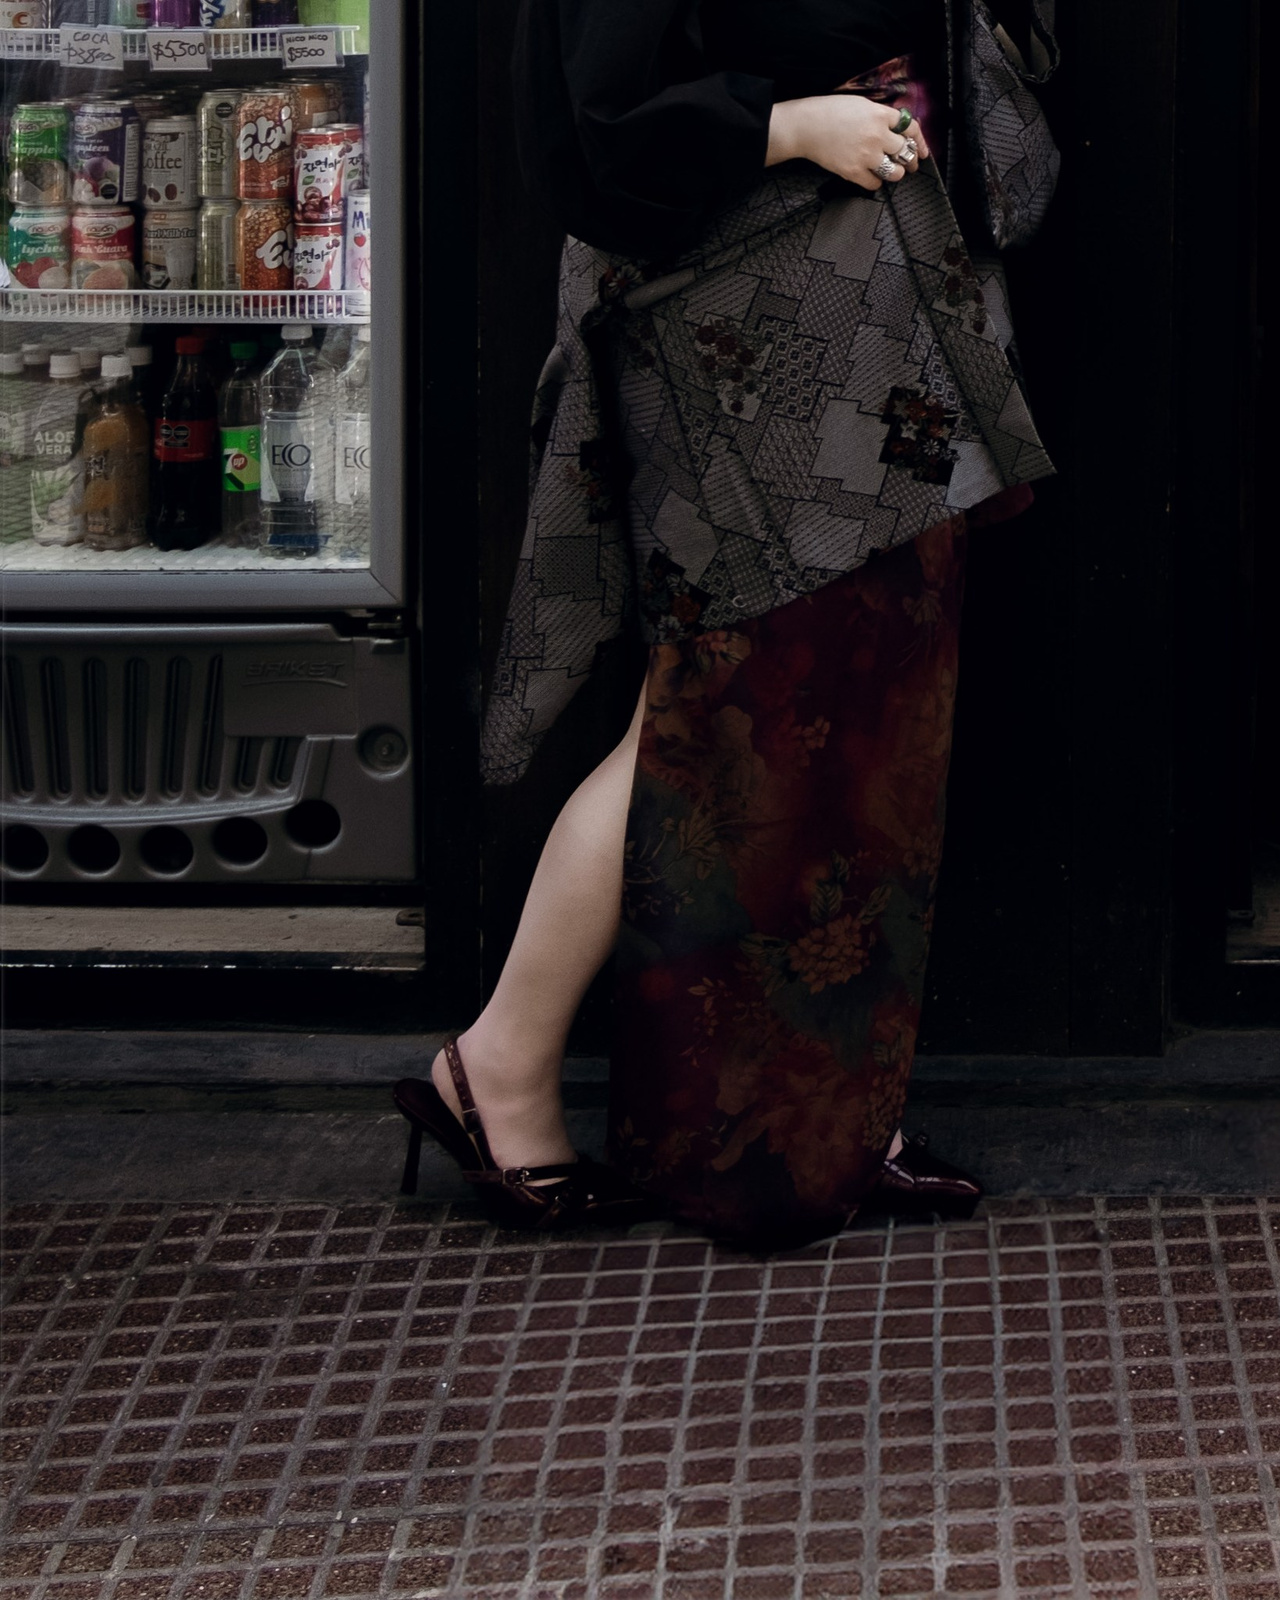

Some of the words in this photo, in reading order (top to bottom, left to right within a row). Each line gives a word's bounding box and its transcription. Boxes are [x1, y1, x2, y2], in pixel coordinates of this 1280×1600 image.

[73, 32, 110, 45] COCA
[37, 444, 73, 455] VERA
[245, 660, 346, 679] BRIKET
